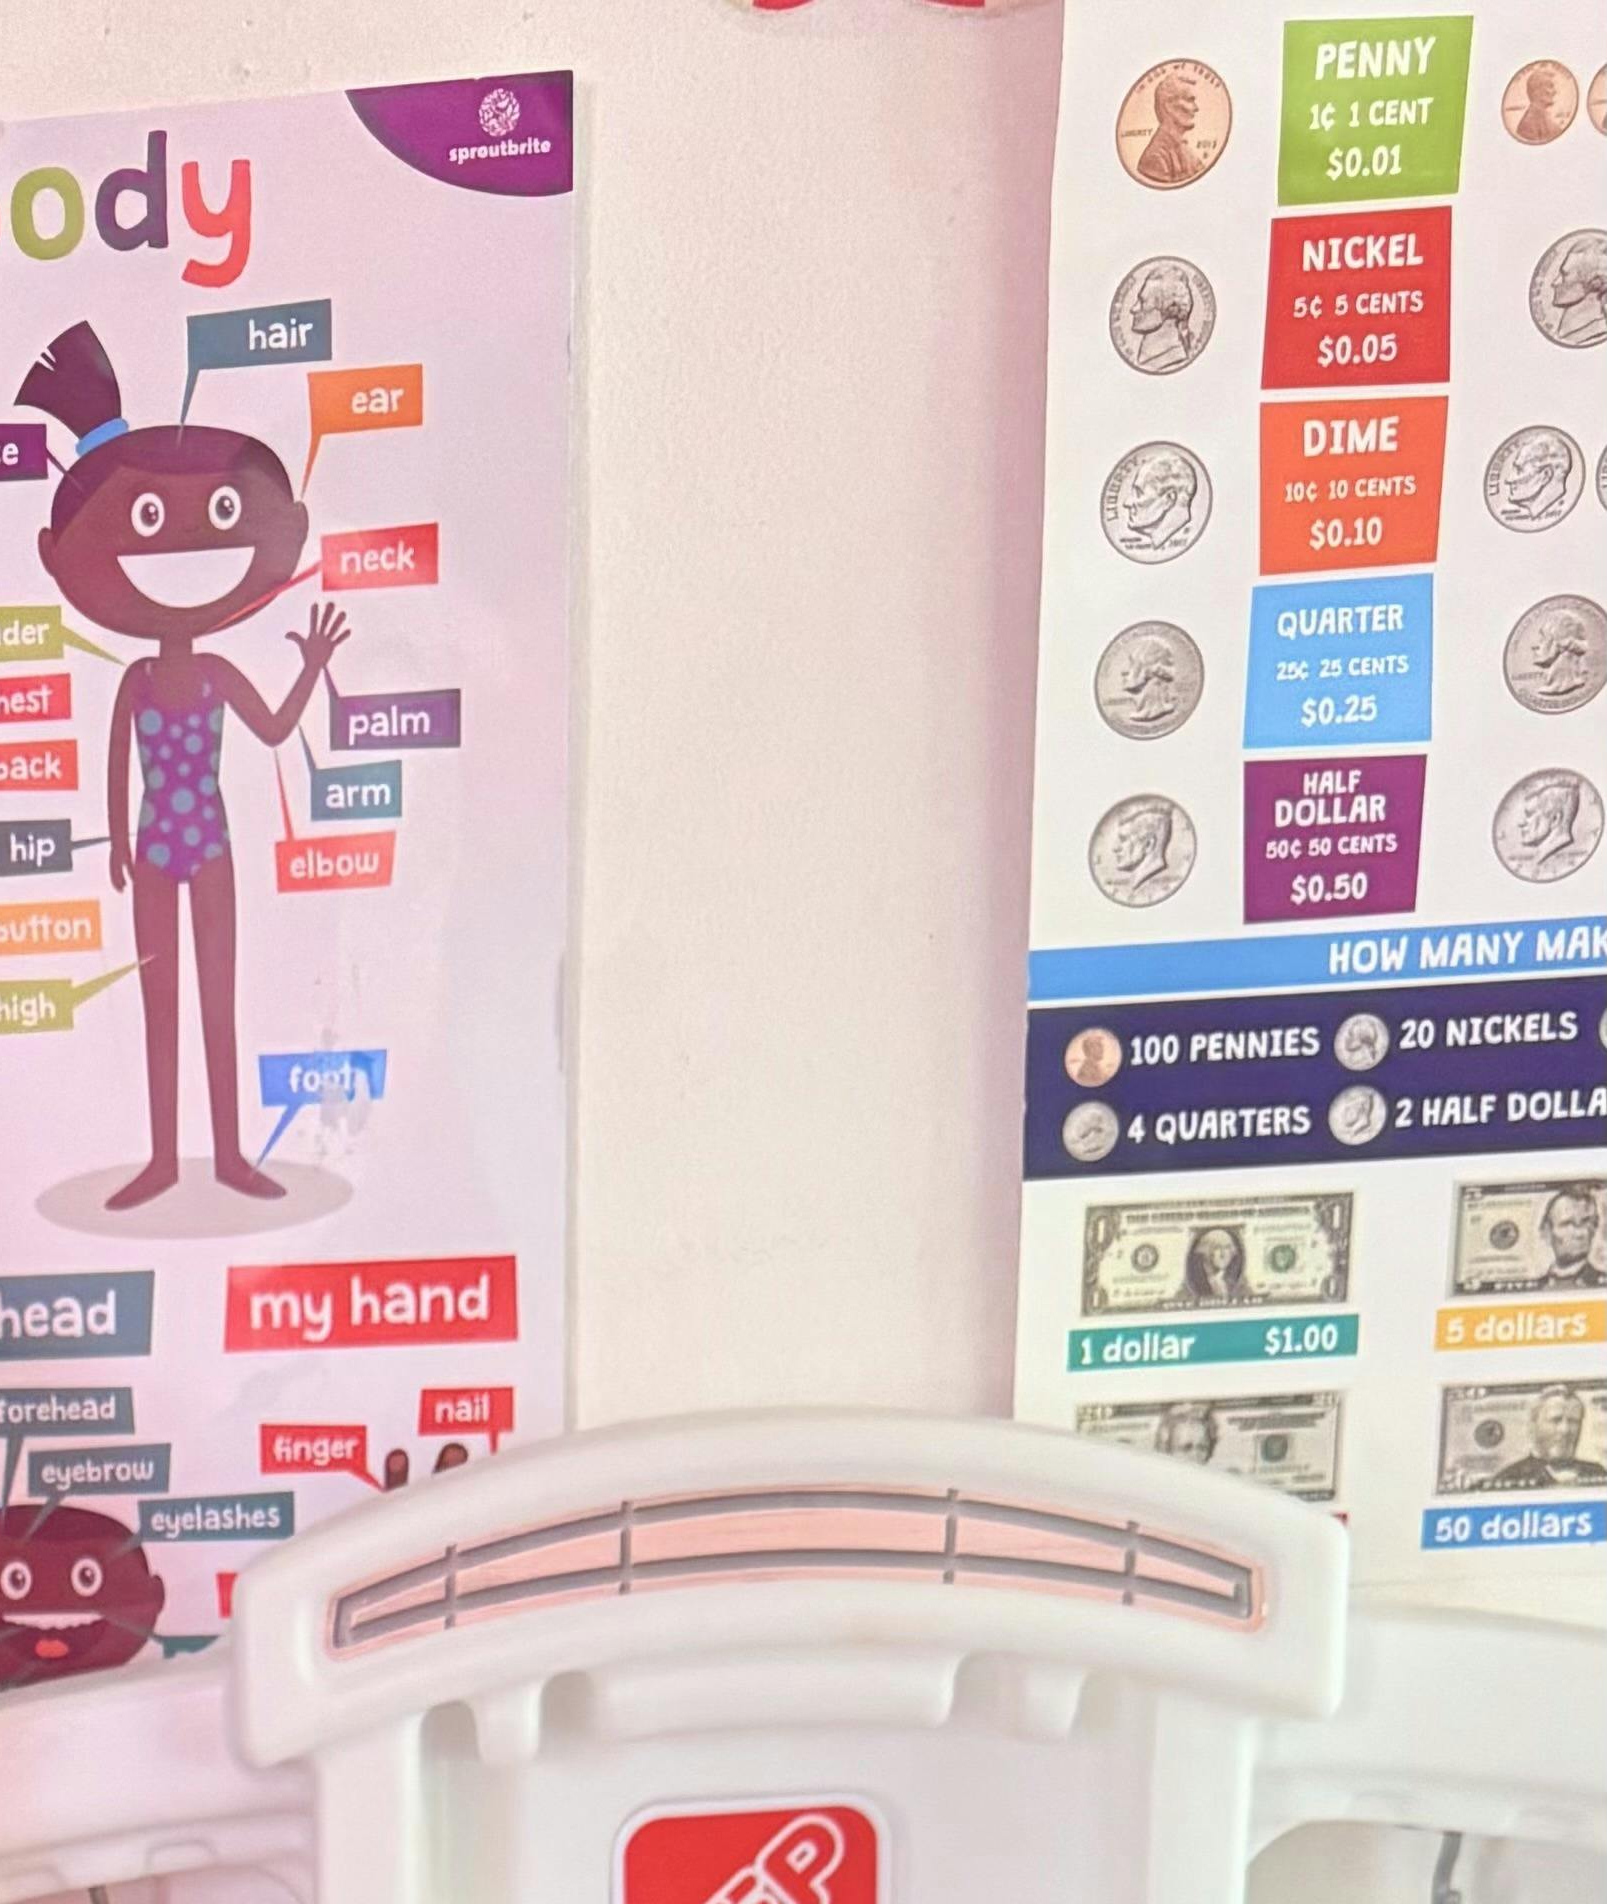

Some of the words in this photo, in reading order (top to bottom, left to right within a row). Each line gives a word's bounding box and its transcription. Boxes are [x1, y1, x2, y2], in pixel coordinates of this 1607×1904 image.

[1315, 36, 1436, 81] PENNY
[1309, 104, 1335, 131] 1¢
[1349, 102, 1360, 128] 1
[1369, 97, 1433, 127] CENT
[449, 138, 550, 164] sproutbrite
[1326, 145, 1403, 181] $0.01
[1302, 233, 1424, 273] NICKEL
[1294, 296, 1322, 320] 5¢
[1335, 295, 1349, 316] 5
[1356, 290, 1423, 316] CENTS
[249, 319, 313, 351] hair
[1318, 334, 1397, 369] $0.05
[351, 387, 404, 414] ear
[1303, 416, 1399, 457] DIME
[1285, 481, 1318, 503] 10¢
[1329, 480, 1348, 500] 10
[1355, 475, 1416, 499] CENTS
[1309, 517, 1383, 552] $0.10
[341, 539, 415, 573] neck
[1277, 604, 1403, 640] QUARTER
[1276, 660, 1308, 682] 25¢
[1319, 658, 1342, 678] 25
[1349, 655, 1409, 677] CENTS
[349, 705, 431, 745] palm
[1301, 694, 1378, 728] $0.25
[326, 781, 392, 810] arm
[1303, 770, 1361, 796] HALF
[1274, 795, 1387, 829] DOLLAR
[10, 834, 56, 862] hip
[290, 848, 380, 878] elbow
[1266, 838, 1302, 861] 50¢
[1308, 837, 1332, 858] 50
[1338, 833, 1397, 856] CENTS
[1291, 871, 1368, 905] $0.50
[1329, 938, 1408, 976] HOW
[1420, 931, 1525, 969] MANY
[1130, 1034, 1178, 1065] 100
[1190, 1026, 1320, 1063] PENNIES
[1400, 1019, 1435, 1048] 20
[1446, 1011, 1578, 1047] NICKELS
[1128, 1118, 1145, 1143] 4
[1154, 1106, 1312, 1145] QUARTERS
[1395, 1100, 1413, 1128] 2
[1423, 1094, 1497, 1126] HALF
[250, 1290, 332, 1342] my
[351, 1274, 490, 1327] hand
[1445, 1322, 1463, 1343] 5
[1474, 1309, 1588, 1342] dollars
[1081, 1339, 1093, 1365] 1
[1102, 1332, 1196, 1365] dollar
[1265, 1322, 1339, 1356] $1.00
[435, 1398, 490, 1424] nail
[273, 1437, 360, 1466] finger
[41, 1457, 154, 1487] eyebrow
[151, 1503, 281, 1533] eyelashes
[1436, 1517, 1471, 1542] 50
[1480, 1507, 1592, 1542] dollars
